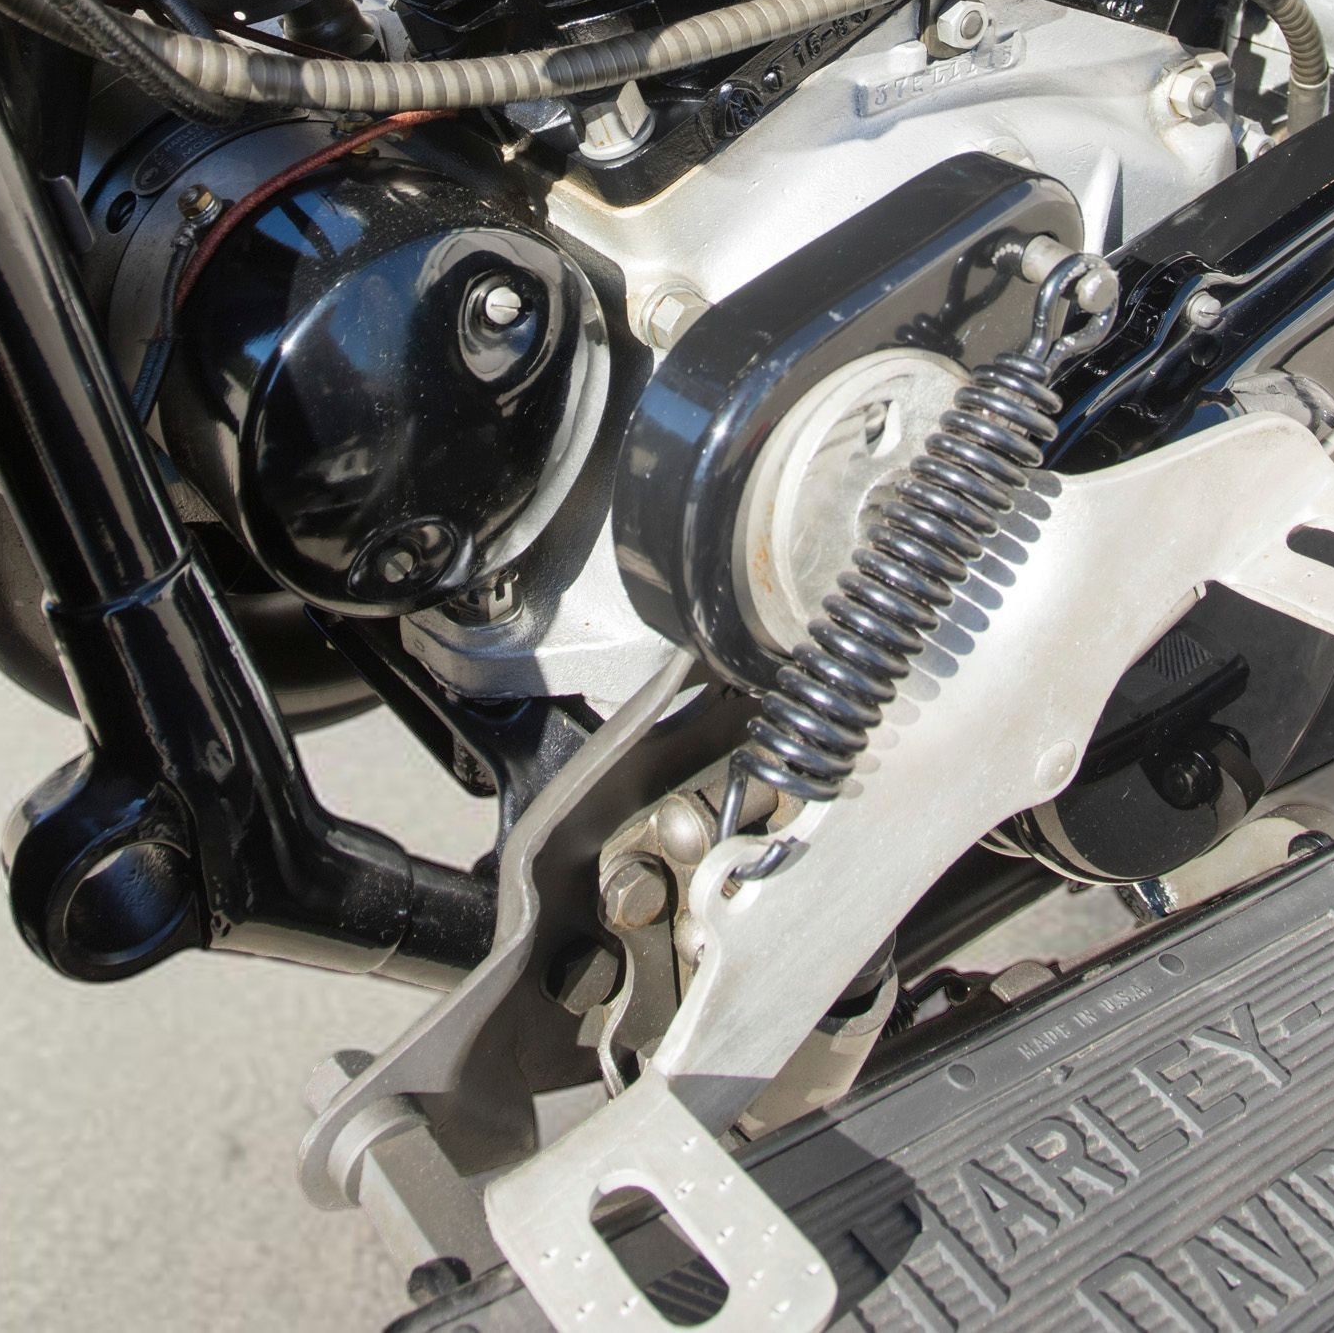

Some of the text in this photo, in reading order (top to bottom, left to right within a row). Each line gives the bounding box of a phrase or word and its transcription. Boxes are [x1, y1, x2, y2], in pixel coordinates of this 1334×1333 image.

[1018, 984, 1154, 1061] MADE IN U.S.A.
